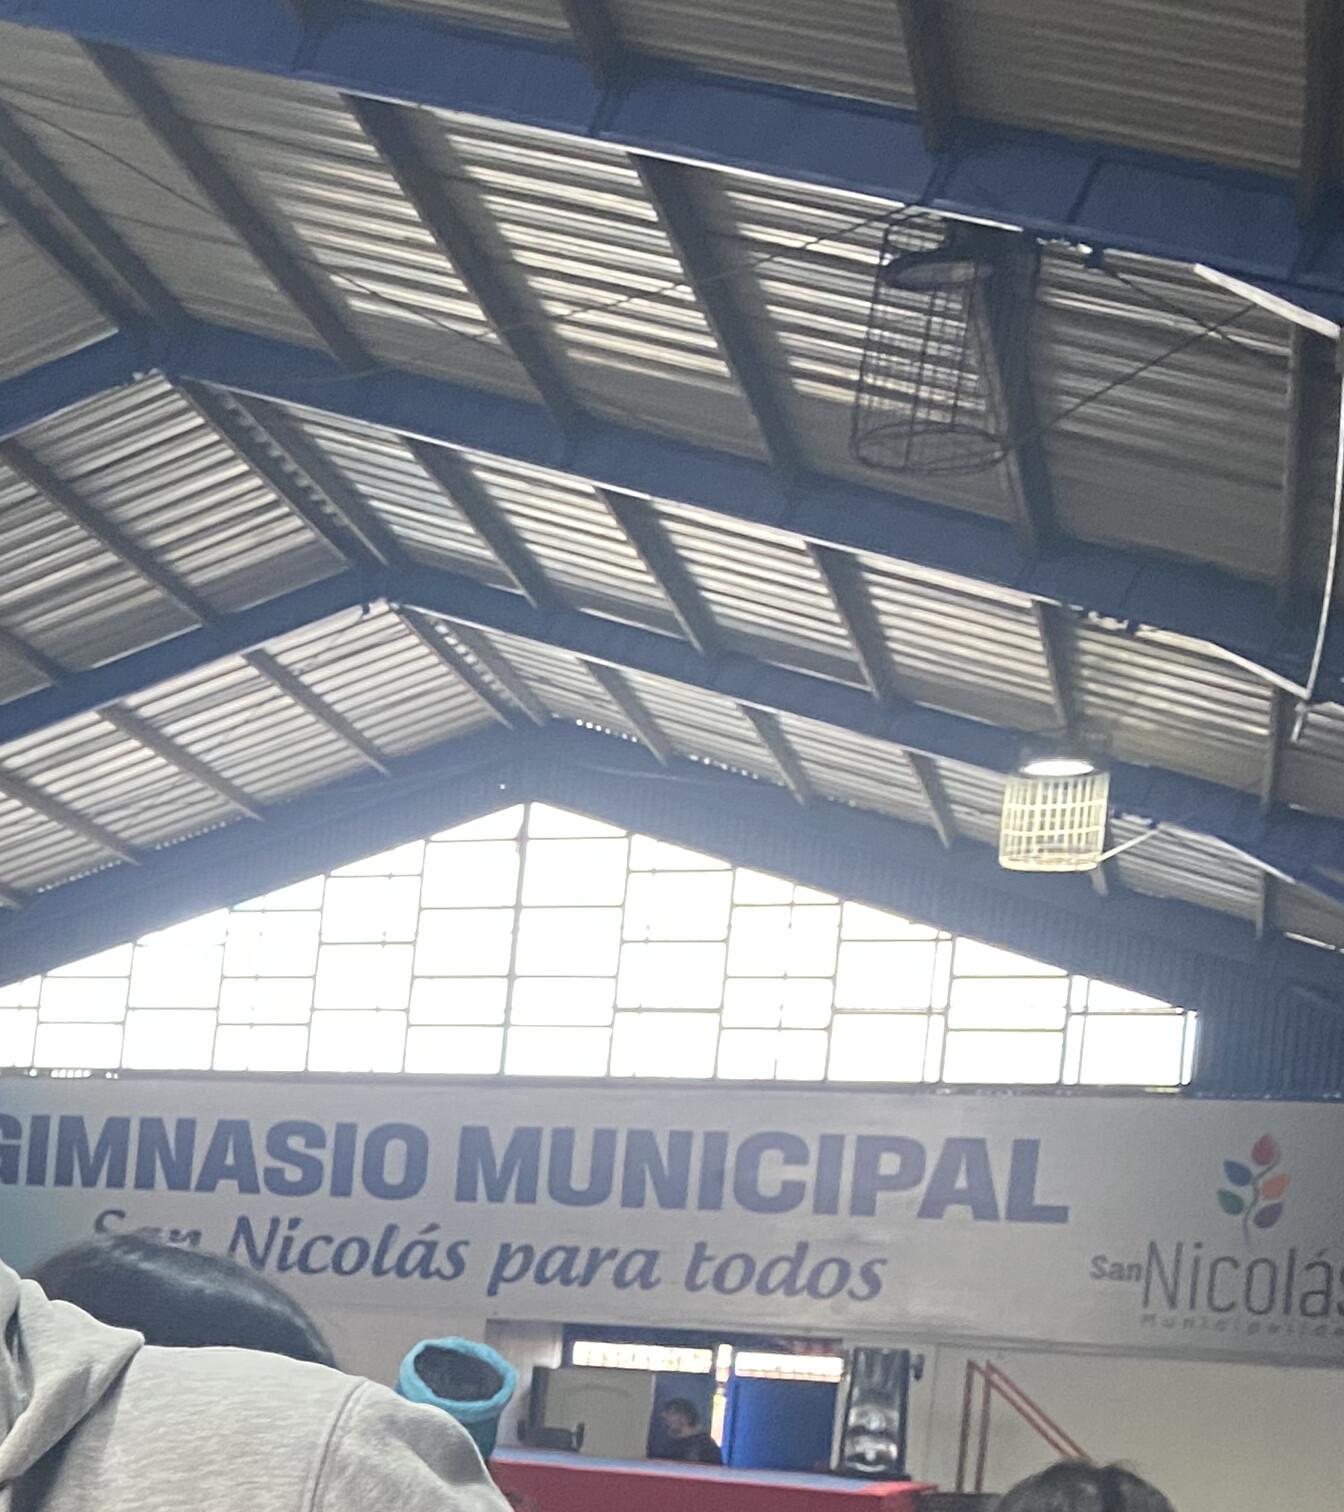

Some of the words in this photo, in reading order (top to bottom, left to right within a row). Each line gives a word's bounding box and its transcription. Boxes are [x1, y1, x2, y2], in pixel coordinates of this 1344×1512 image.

[454, 1124, 1070, 1225] MUNICIPAL
[226, 1214, 471, 1281] Nicolás
[486, 1240, 661, 1298] para
[684, 1240, 889, 1301] todos
[1089, 1254, 1143, 1282] San
